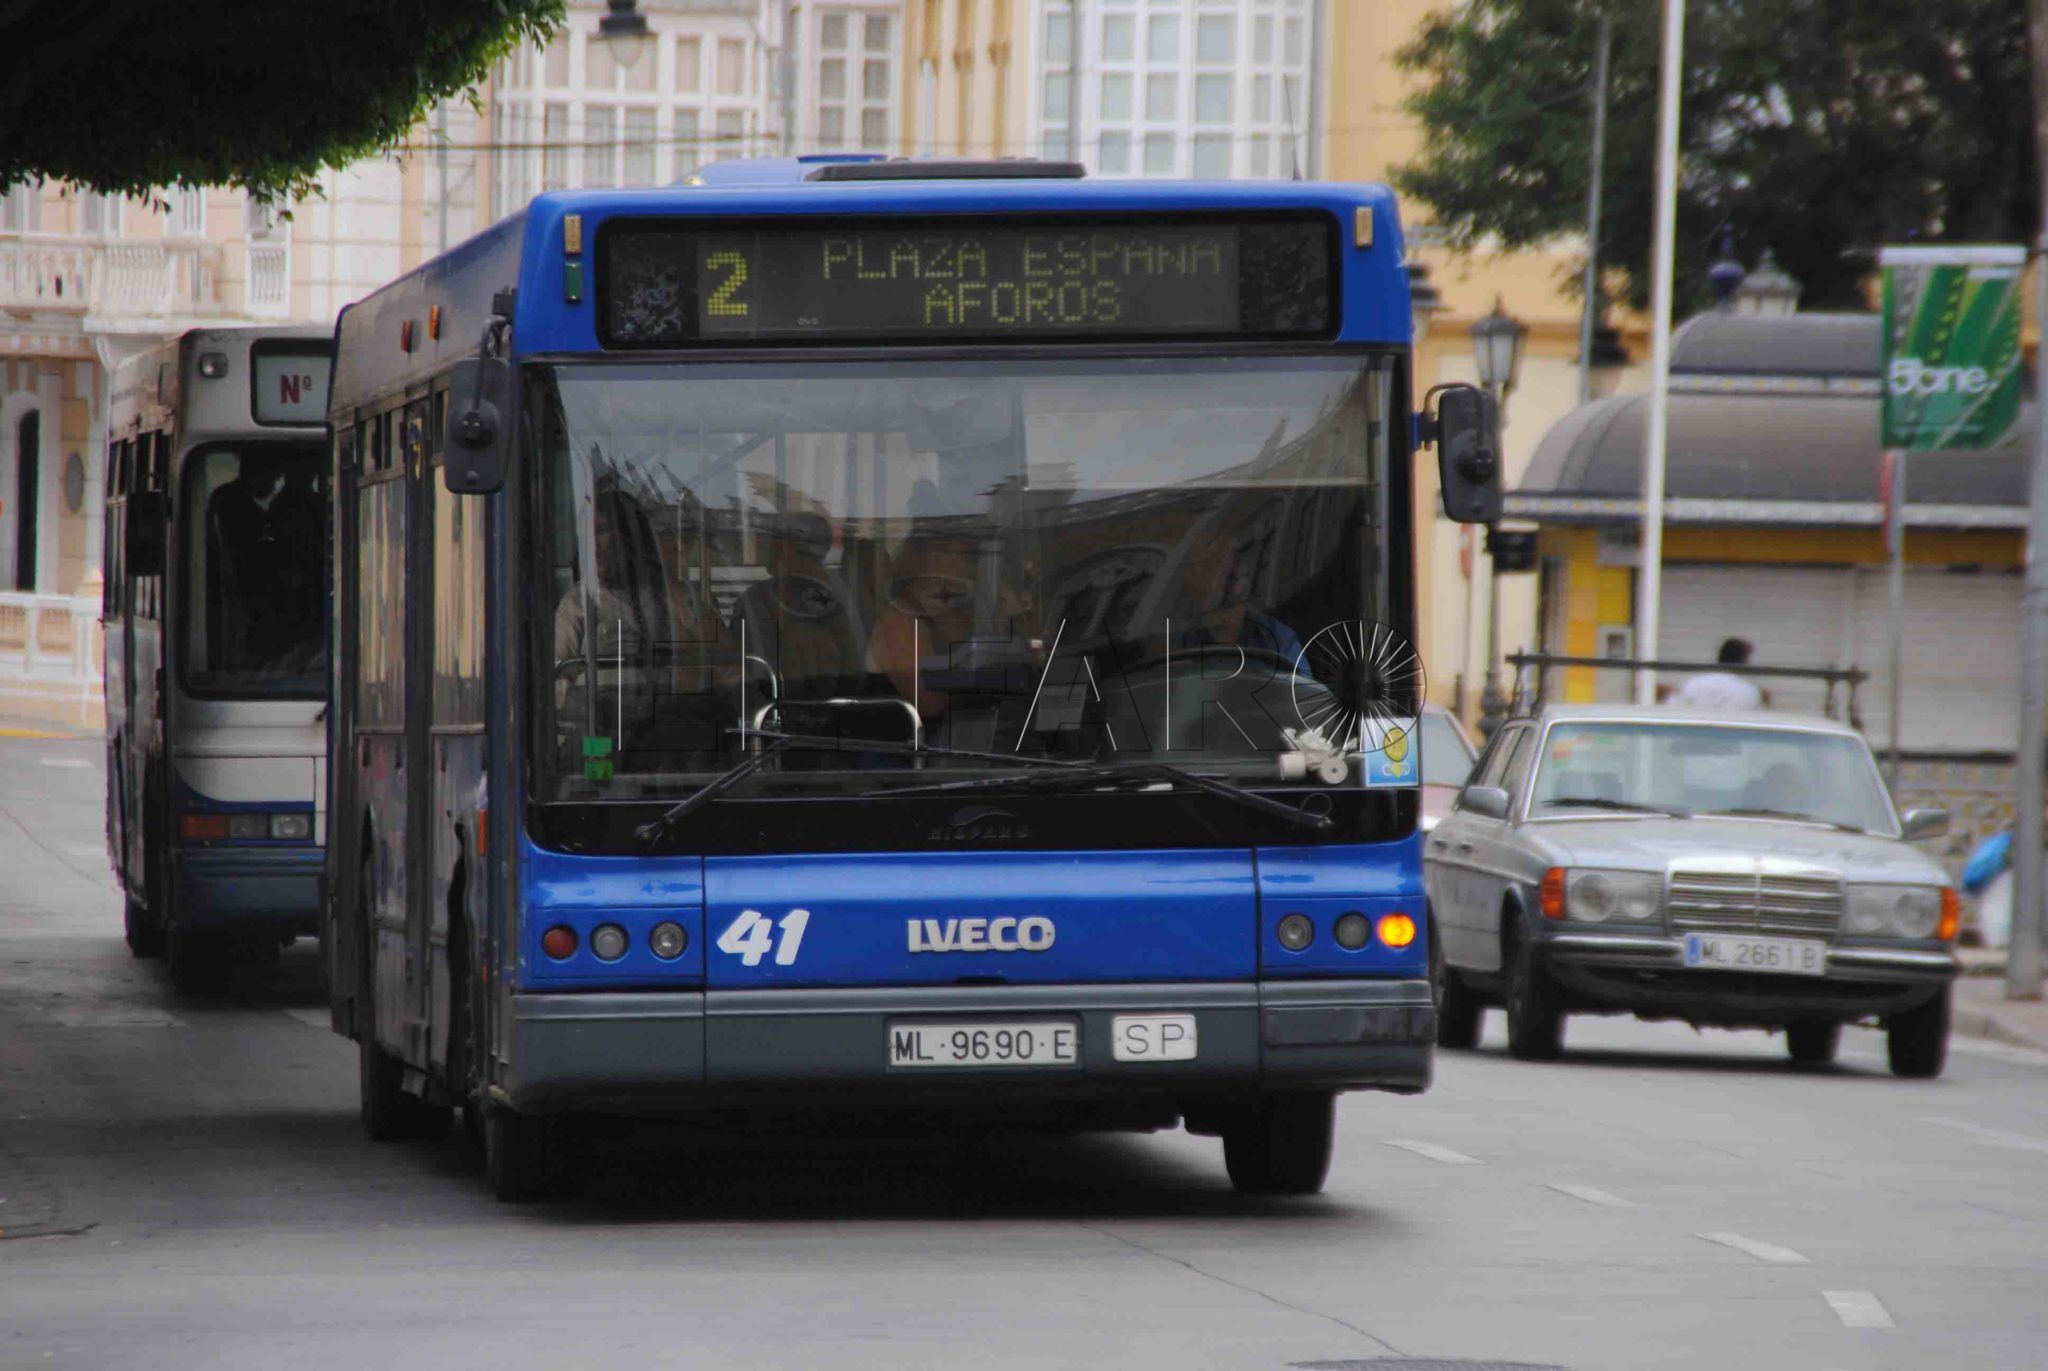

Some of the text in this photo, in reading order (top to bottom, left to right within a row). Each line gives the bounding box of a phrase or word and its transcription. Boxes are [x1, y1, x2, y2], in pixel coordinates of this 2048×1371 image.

[822, 240, 988, 279] PLAZA
[706, 251, 749, 316] 2
[923, 281, 1122, 325] AFOROS
[717, 909, 810, 966] 41
[907, 917, 1056, 953] IVECO
